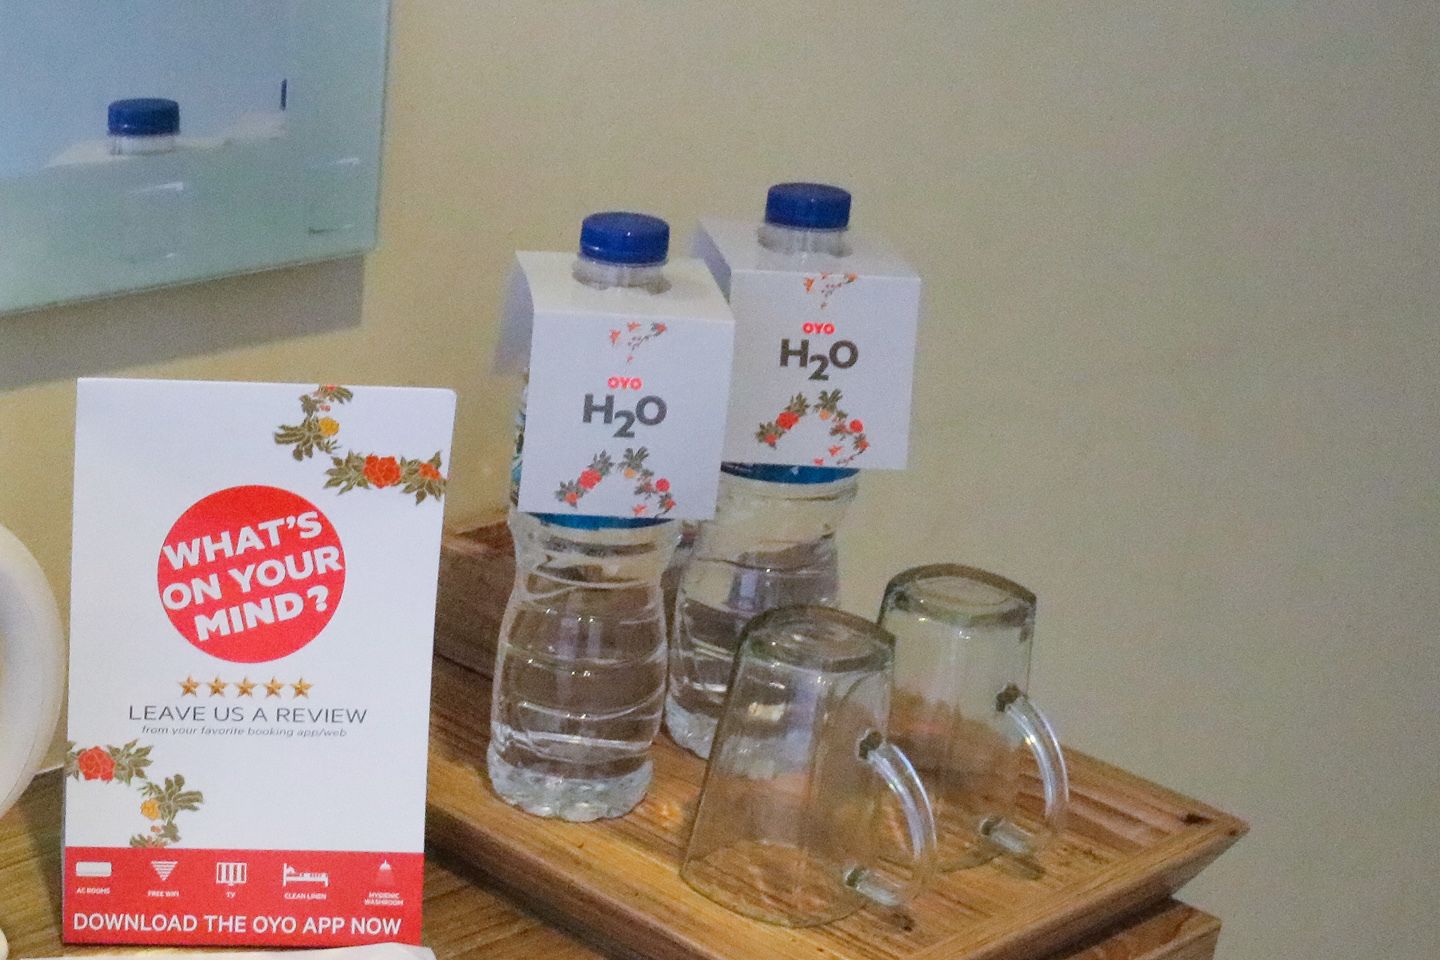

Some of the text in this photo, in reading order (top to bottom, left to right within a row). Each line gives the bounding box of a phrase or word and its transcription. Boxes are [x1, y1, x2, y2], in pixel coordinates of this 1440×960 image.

[802, 322, 835, 335] OYO
[607, 376, 642, 390] OYO
[163, 511, 323, 571] WHAT'S
[162, 545, 343, 611] ON YOUR
[129, 705, 367, 723] LEAVE US A REVIEW
[141, 725, 347, 739] from your favorite booking app/web
[307, 892, 327, 900] LINEN
[73, 912, 402, 935] DOWNLOAD THE OYO APP NOW
